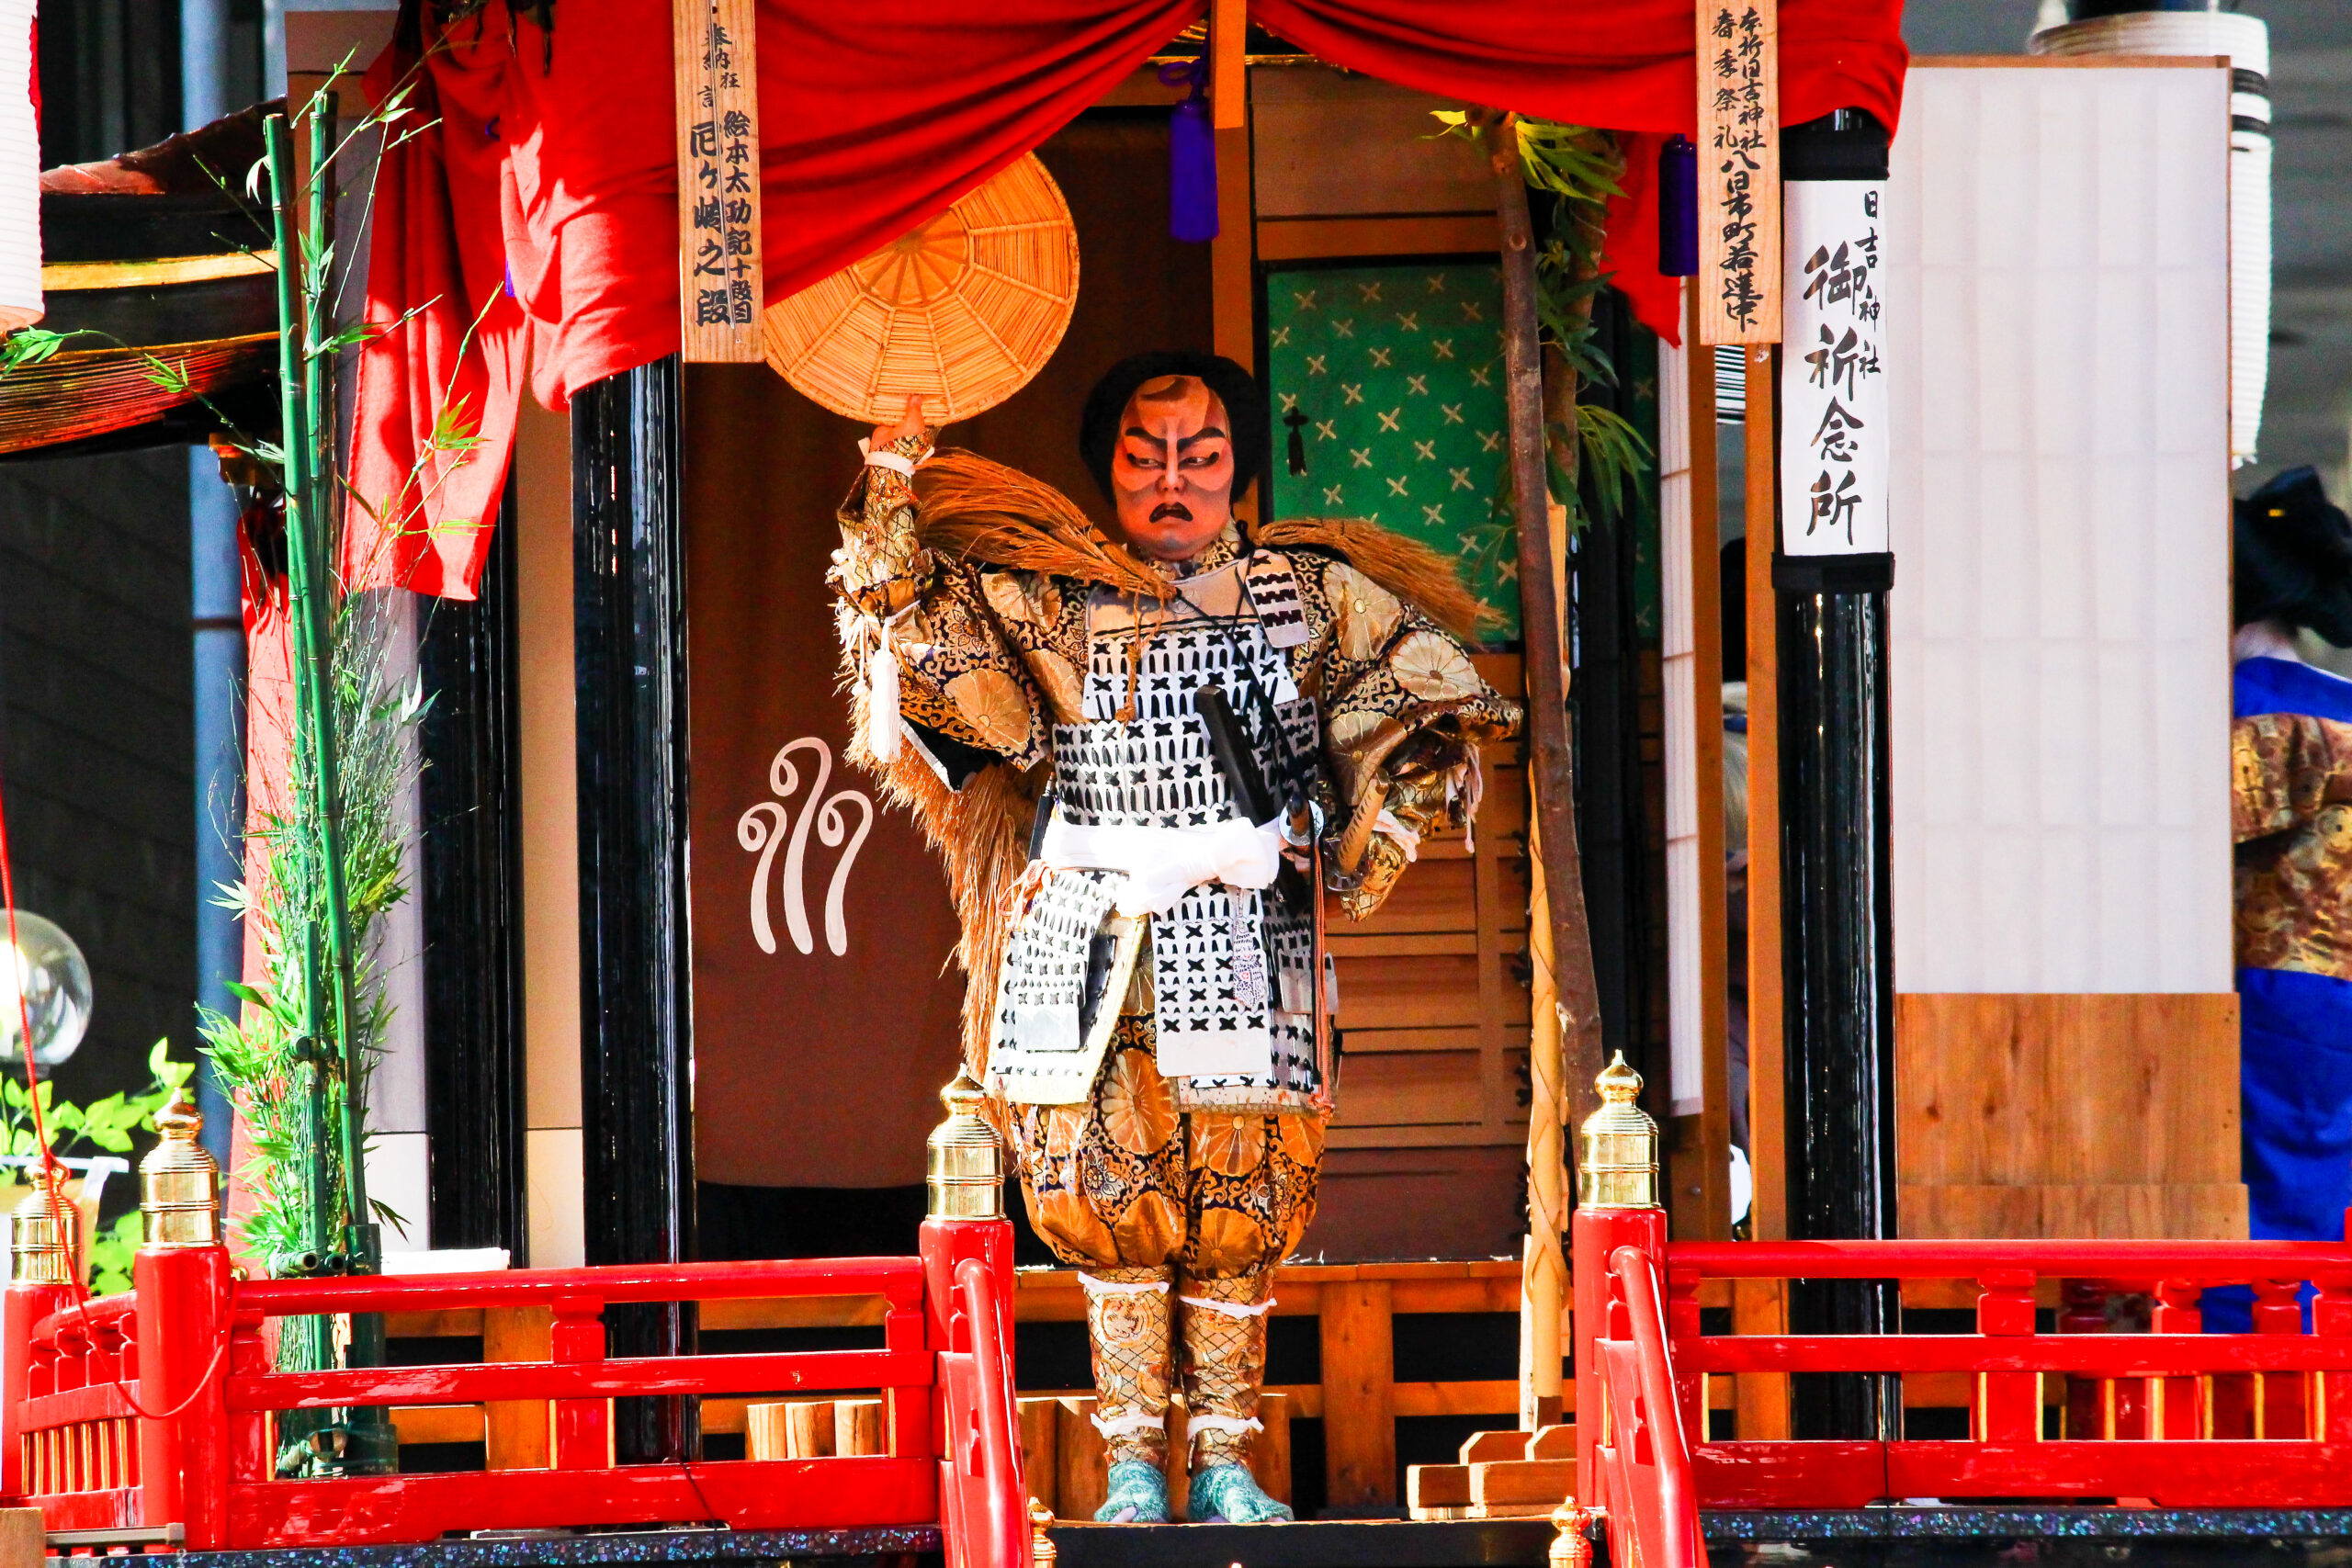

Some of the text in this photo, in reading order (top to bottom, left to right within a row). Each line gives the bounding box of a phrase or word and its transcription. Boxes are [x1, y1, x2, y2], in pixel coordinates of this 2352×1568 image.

[1712, 8, 1740, 149] 春季祭礼
[1854, 190, 1882, 379] 日吉神社
[1804, 240, 1867, 546] 御祈念所
